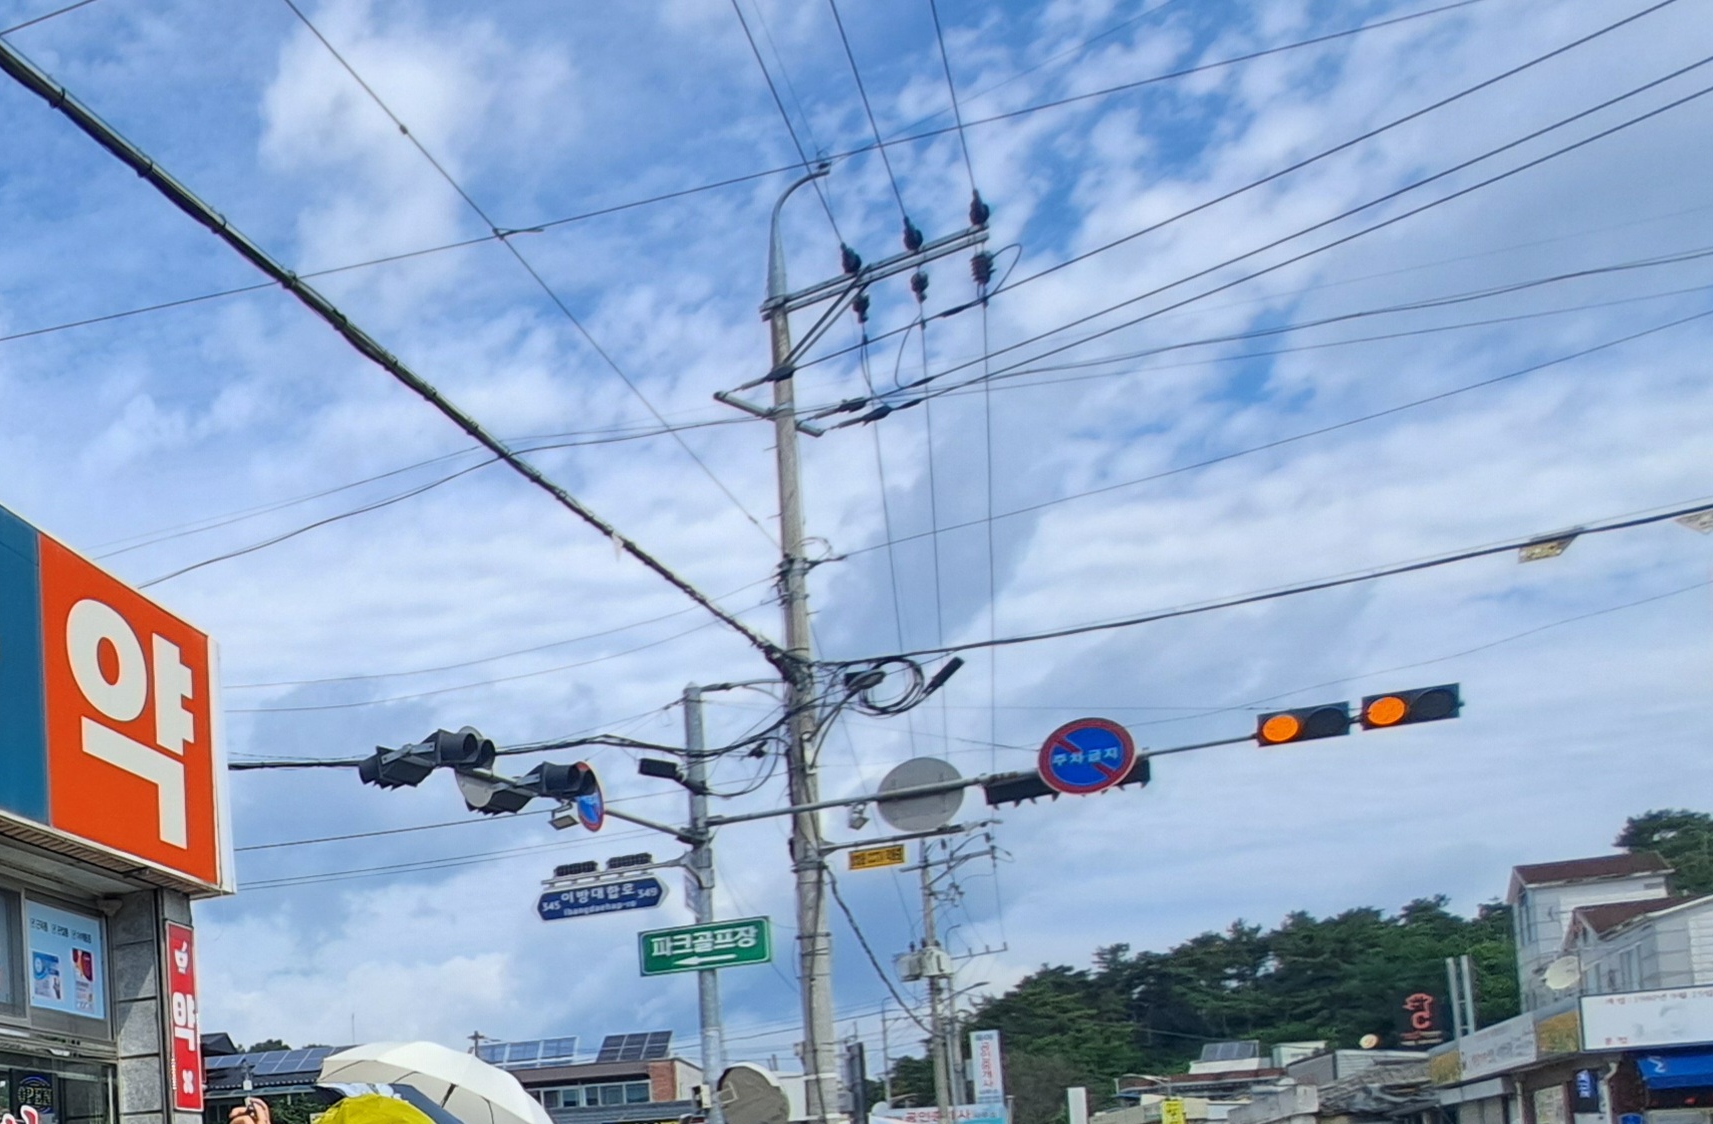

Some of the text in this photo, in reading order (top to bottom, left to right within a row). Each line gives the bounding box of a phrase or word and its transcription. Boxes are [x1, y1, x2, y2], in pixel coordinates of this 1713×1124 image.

[65, 599, 194, 849] 약
[1051, 746, 1118, 767] 주차금지
[542, 900, 561, 912] 345
[561, 882, 636, 904] 이방대합로
[651, 925, 759, 957] 파크골프장
[173, 991, 197, 1052] 약
